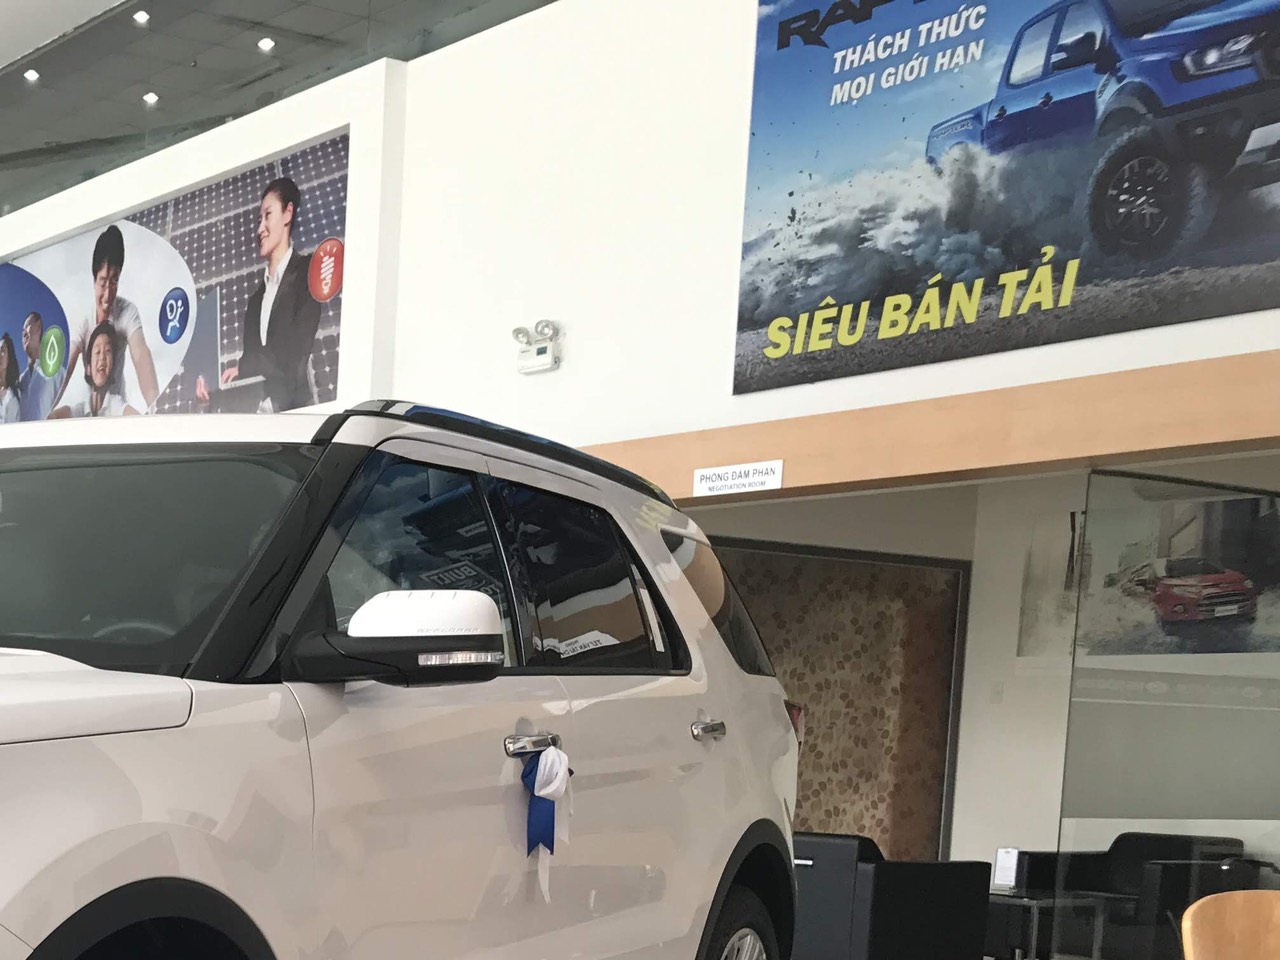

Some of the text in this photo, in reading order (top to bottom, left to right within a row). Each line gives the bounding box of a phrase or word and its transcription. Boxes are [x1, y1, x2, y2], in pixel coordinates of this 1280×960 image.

[830, 38, 986, 106] MỌI GIỚI HẠN
[833, 4, 988, 74] THÁCH THỨC
[763, 245, 1081, 359] SIÊU BÁN TẢI
[708, 480, 766, 492] NEGOTIATION ROOM
